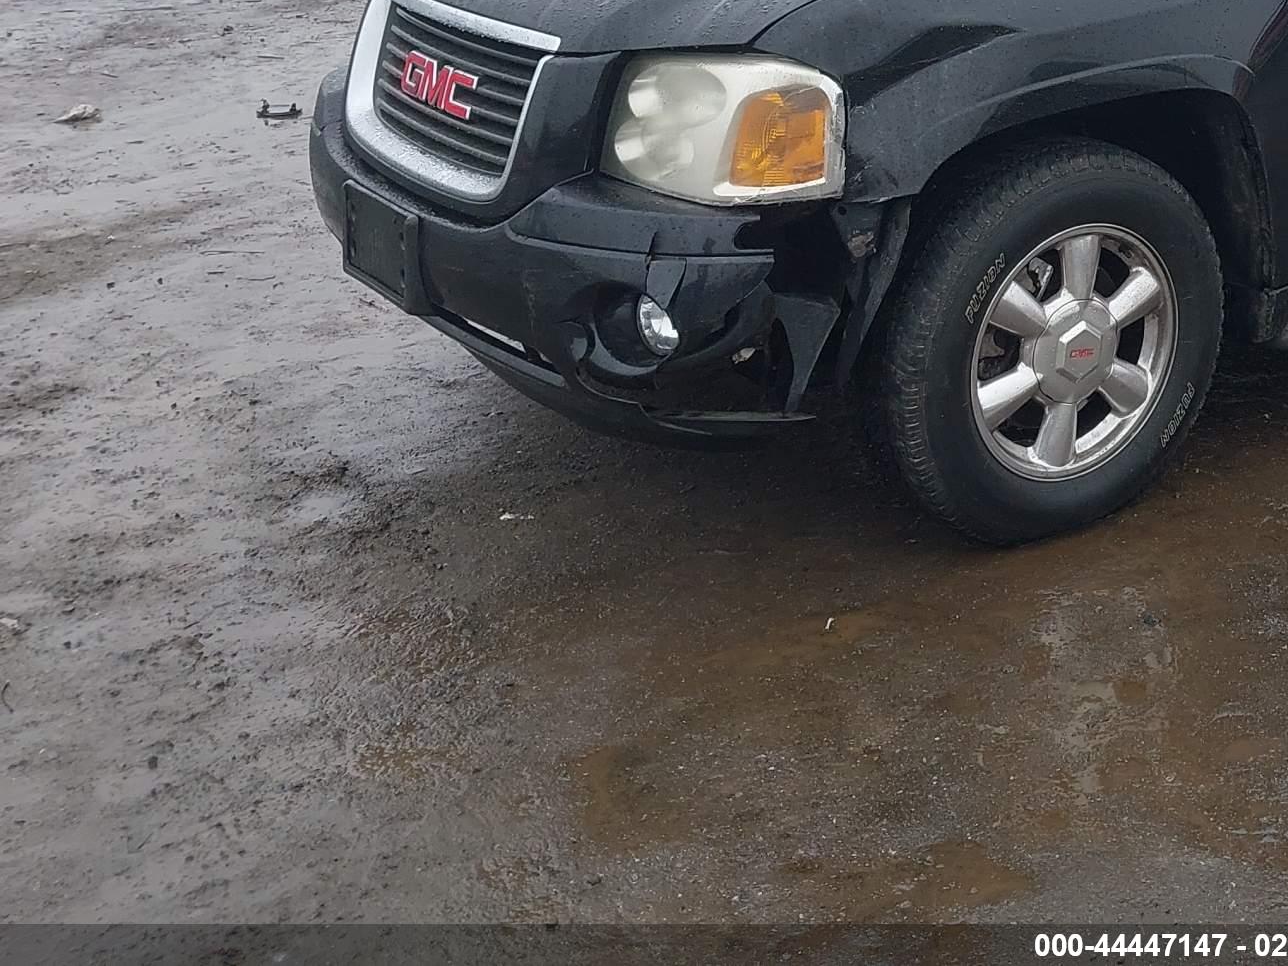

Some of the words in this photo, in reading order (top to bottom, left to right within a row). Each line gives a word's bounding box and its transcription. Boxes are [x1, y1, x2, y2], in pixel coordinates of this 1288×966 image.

[401, 50, 479, 120] GMC
[965, 252, 1006, 324] FUZION
[1160, 381, 1196, 448] FUZION
